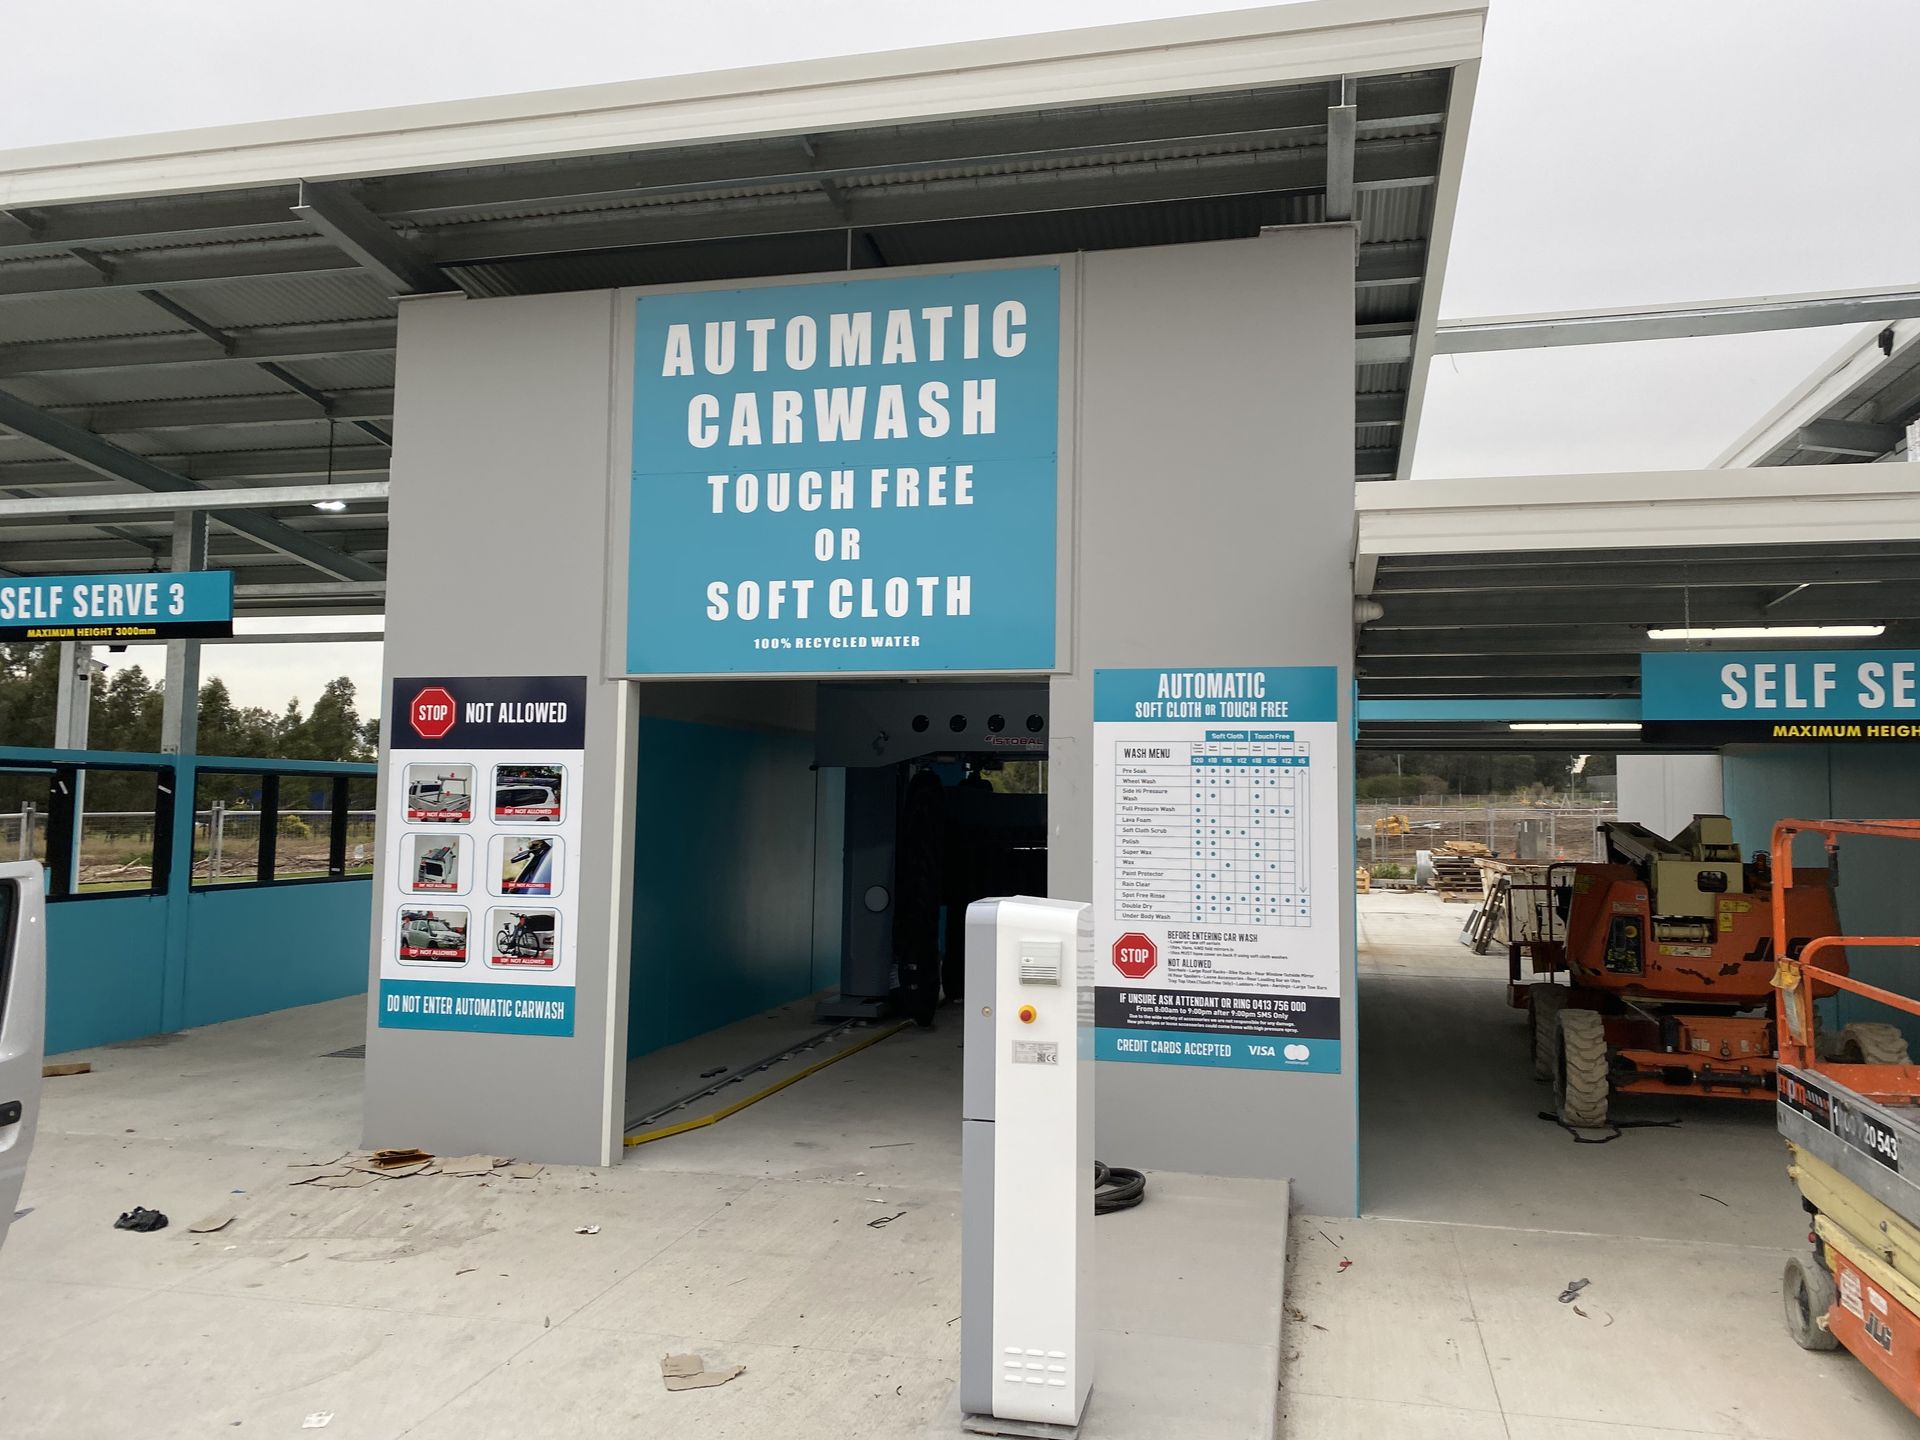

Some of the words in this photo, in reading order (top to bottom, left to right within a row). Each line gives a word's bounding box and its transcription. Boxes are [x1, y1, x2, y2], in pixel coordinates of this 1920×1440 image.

[661, 300, 1028, 377] AUTOMATIC
[687, 378, 997, 449] CARWASH
[706, 470, 854, 514] TOUCH
[870, 464, 974, 509] FREE
[814, 527, 861, 562] OR
[0, 585, 64, 620] SELF
[72, 582, 159, 618] SERVE
[167, 582, 186, 616] 3
[706, 580, 815, 621] SOFT
[828, 575, 972, 619] CLOTH
[26, 628, 75, 638] MAXIMUM
[76, 627, 113, 637] HEIGHT
[115, 626, 157, 637] 3000mm
[753, 637, 792, 651] 100%
[794, 636, 868, 651] RECYCLED
[870, 634, 920, 650] WATER
[1157, 671, 1266, 700] AUTOMATIC
[1720, 662, 1838, 710] SELF
[419, 703, 449, 721] STOP
[464, 701, 495, 723] NOT
[497, 701, 568, 723] ALLOWED
[1135, 701, 1164, 719] SOFT
[1165, 701, 1203, 719] CLOTH
[1204, 704, 1217, 716] OR
[1219, 701, 1258, 718] TOUCH
[1260, 701, 1289, 718] FREE
[1772, 725, 1862, 738] MAXIMUM
[1123, 748, 1148, 759] WASH
[1148, 748, 1171, 759] MENU
[1167, 930, 1191, 940] BEFORE
[1191, 931, 1223, 941] ENTERING
[1223, 932, 1238, 942] CAR
[1238, 933, 1259, 943] WASH
[1120, 948, 1150, 963] STOP
[1167, 958, 1181, 967] NOT
[1181, 958, 1213, 969] ALLOWED
[387, 994, 401, 1012] DO
[401, 994, 421, 1013] NOT
[422, 995, 453, 1015] ENTER
[454, 996, 513, 1018] AUTOMATIC
[514, 999, 566, 1020] CARWASH
[1119, 993, 1128, 1003] IF
[1128, 993, 1158, 1005] UNSURE
[1158, 995, 1174, 1006] ASK
[1175, 995, 1220, 1008] ATTENDANT
[1220, 998, 1232, 1008] OR
[1233, 998, 1251, 1010] RING
[1252, 999, 1273, 1011] 0413
[1273, 1000, 1290, 1011] 756
[1290, 1001, 1307, 1013] 000
[1136, 1005, 1154, 1013] From
[1153, 1006, 1180, 1014] 8:00am
[1187, 1008, 1213, 1017] 9:00pm
[1231, 1010, 1257, 1019] 9:00pm
[1273, 1012, 1289, 1021] Only
[1116, 1039, 1149, 1053] CREDIT
[1150, 1041, 1182, 1055] CARDS
[1183, 1042, 1232, 1058] ACCEPTED
[1248, 1044, 1276, 1057] VISA
